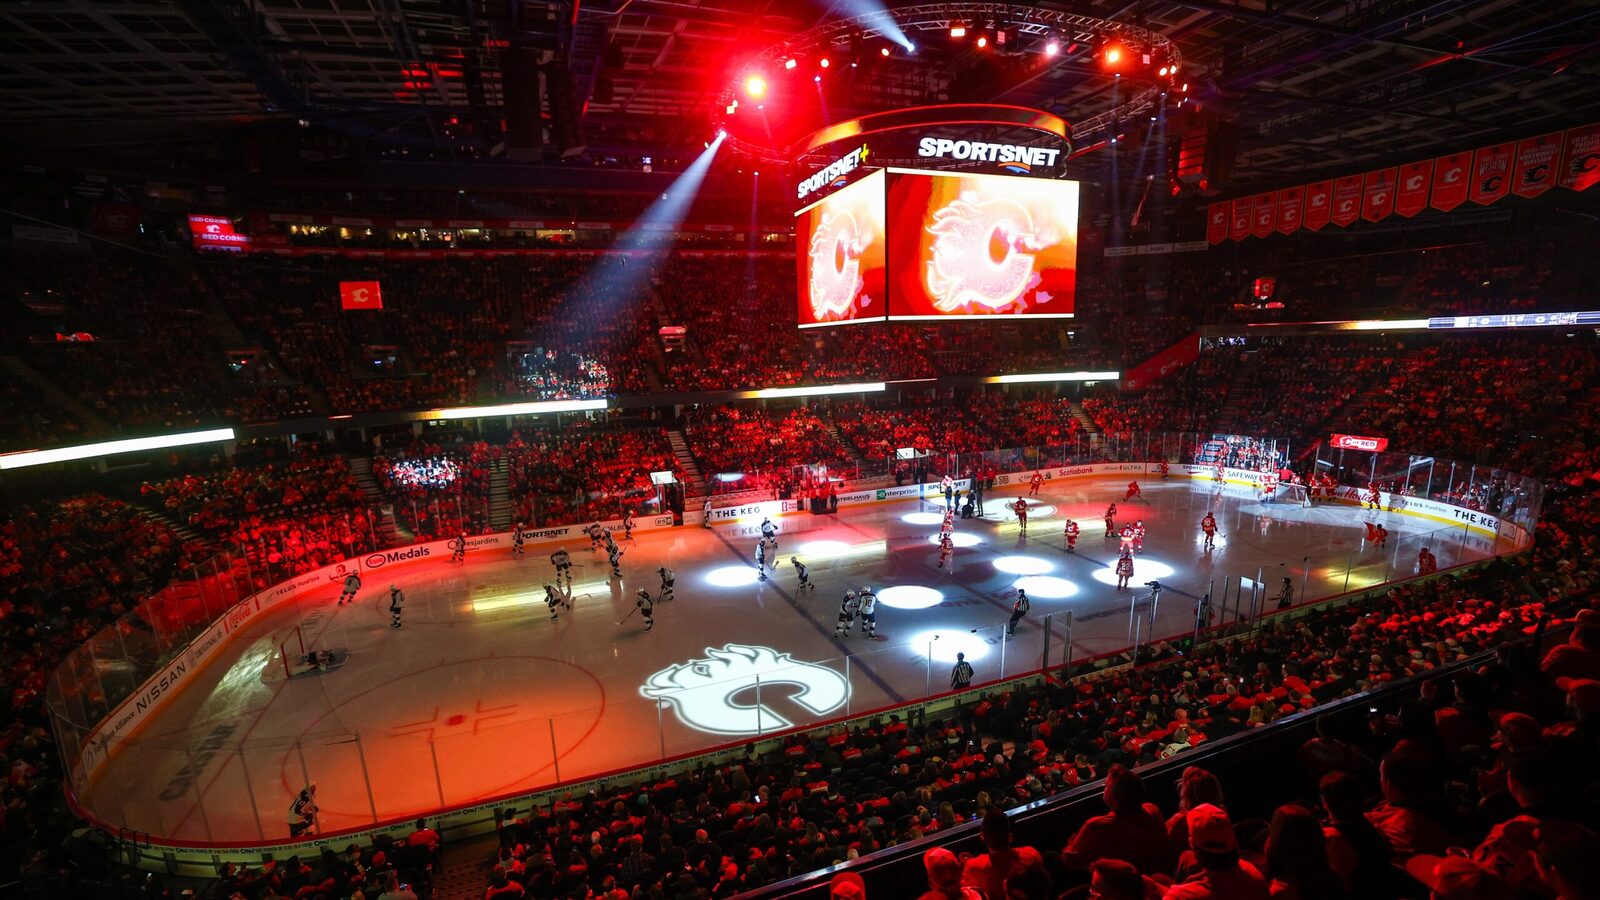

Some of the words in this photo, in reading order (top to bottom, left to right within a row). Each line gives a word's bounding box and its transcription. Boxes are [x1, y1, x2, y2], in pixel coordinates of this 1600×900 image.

[919, 137, 1060, 167] SPORTSNET
[1059, 466, 1094, 476] Scotiabank
[1227, 470, 1258, 480] SAFEWAY
[880, 489, 917, 498] enterprise
[1402, 500, 1423, 508] TELUS
[715, 510, 736, 518] THE
[740, 506, 760, 515] KEG
[1454, 509, 1477, 523] THE
[1480, 517, 1498, 530] KEG
[465, 536, 498, 547] esjardins
[387, 546, 430, 562] Medals
[1120, 562, 1130, 570] 22
[276, 583, 296, 596] TELUS
[136, 662, 186, 714] NISSAN
